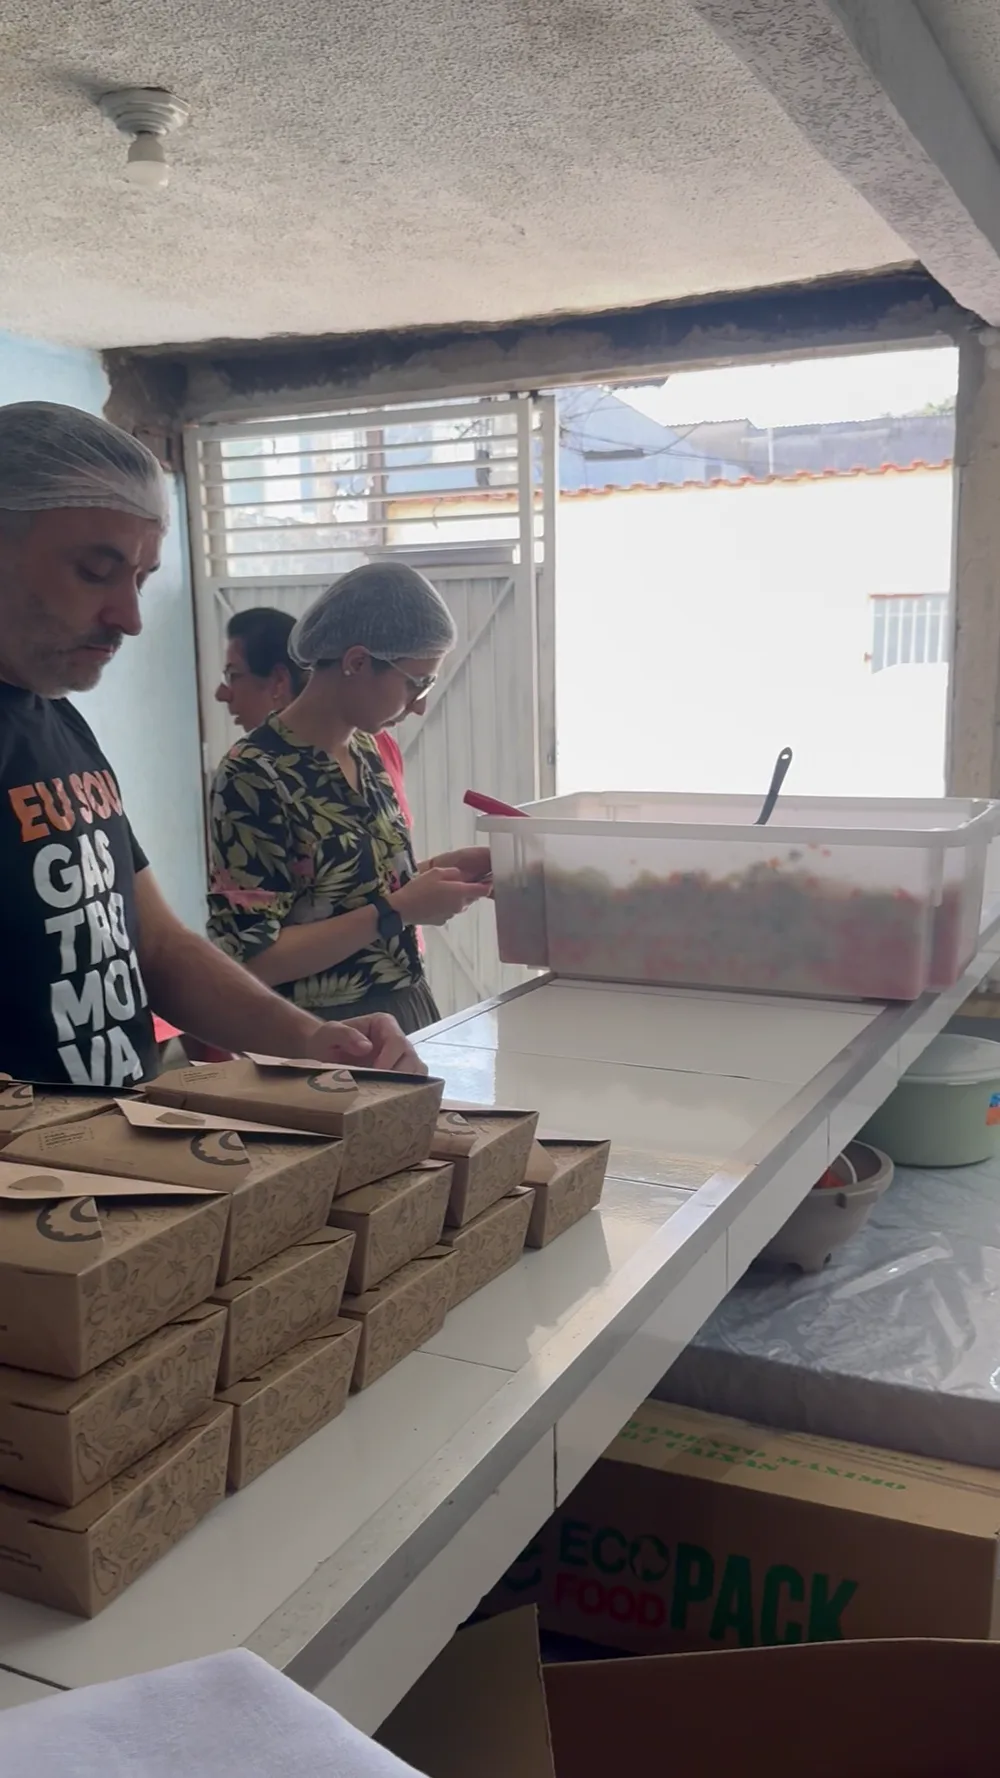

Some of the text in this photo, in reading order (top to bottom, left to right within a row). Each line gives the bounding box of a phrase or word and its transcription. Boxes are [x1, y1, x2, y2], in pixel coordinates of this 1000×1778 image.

[8, 769, 122, 842] EU SOU
[33, 829, 115, 908] GAS
[44, 892, 130, 974] TRO
[57, 1025, 144, 1087] VA
[560, 1519, 671, 1582] ECO
[554, 1571, 668, 1629] FOOD
[669, 1541, 859, 1649] PACK
